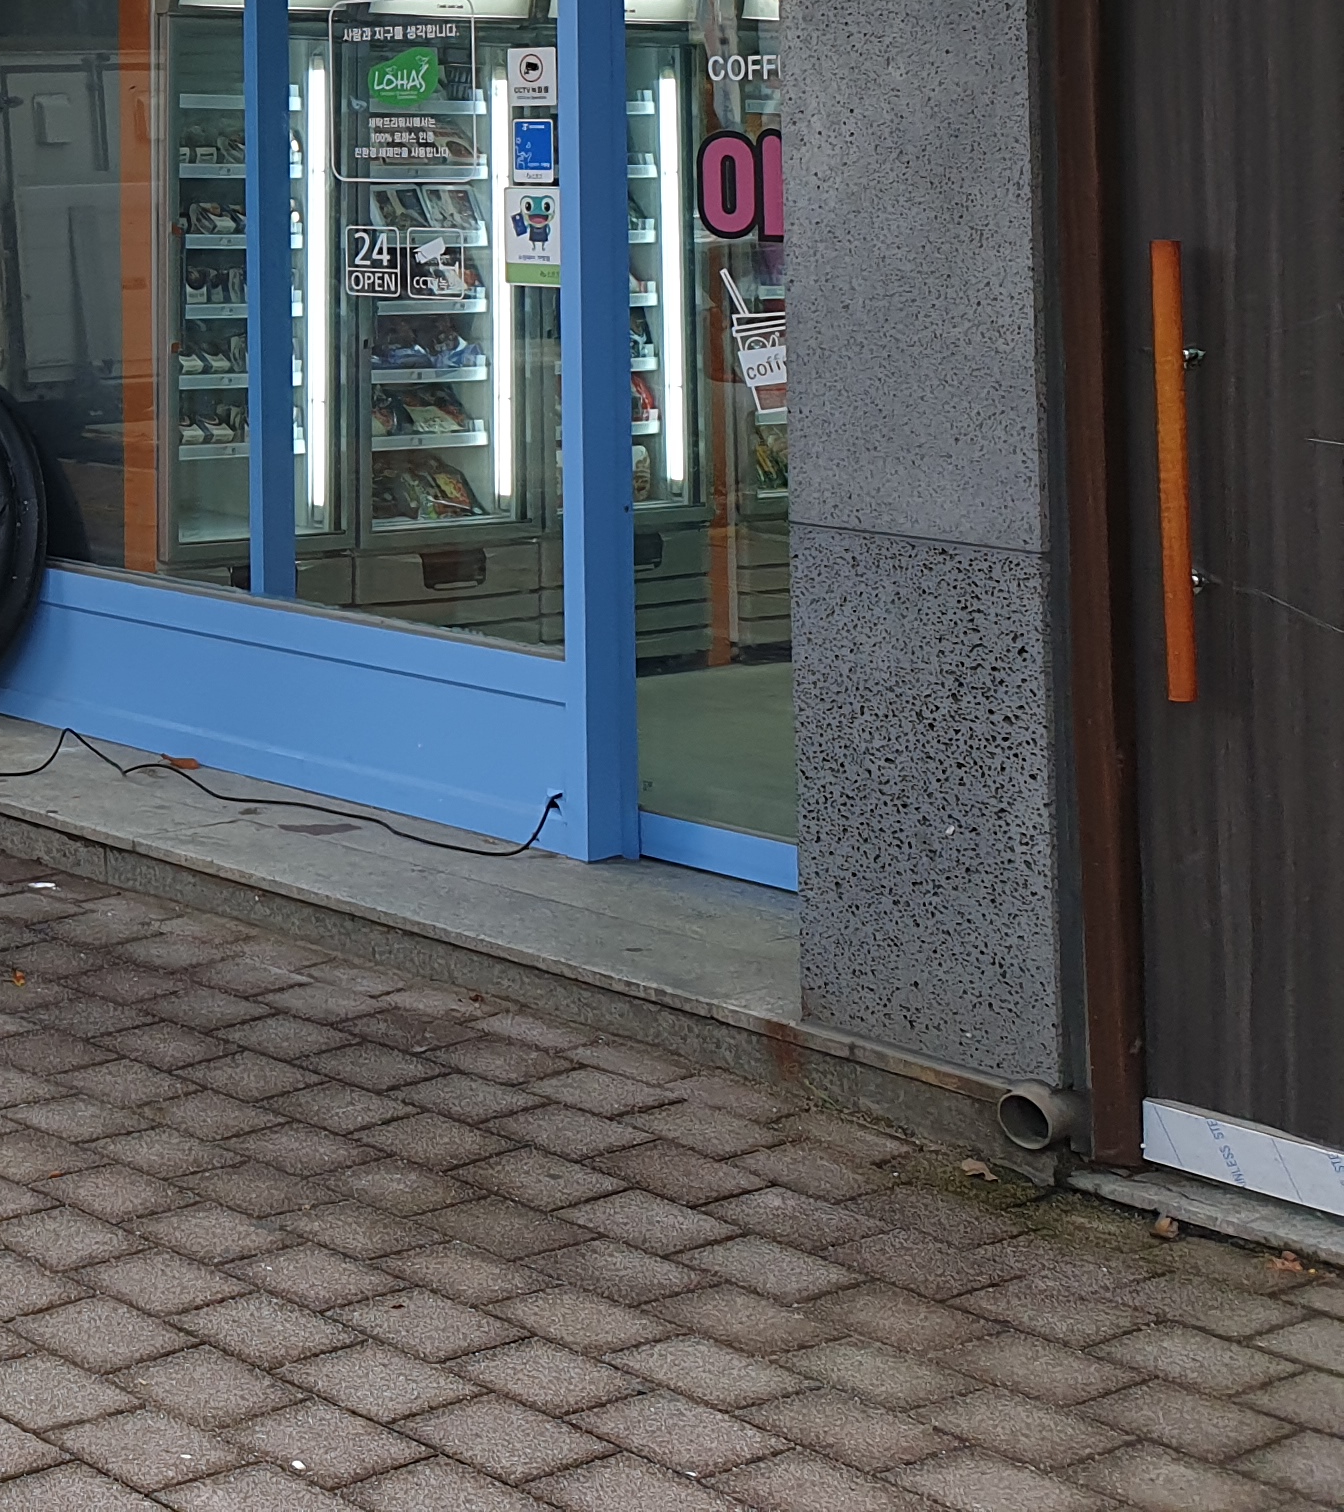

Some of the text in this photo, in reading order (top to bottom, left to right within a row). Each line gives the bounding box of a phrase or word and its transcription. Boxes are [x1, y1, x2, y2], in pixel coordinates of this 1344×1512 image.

[373, 63, 430, 93] LOHAS
[354, 231, 391, 266] 24
[351, 271, 396, 292] OPEN
